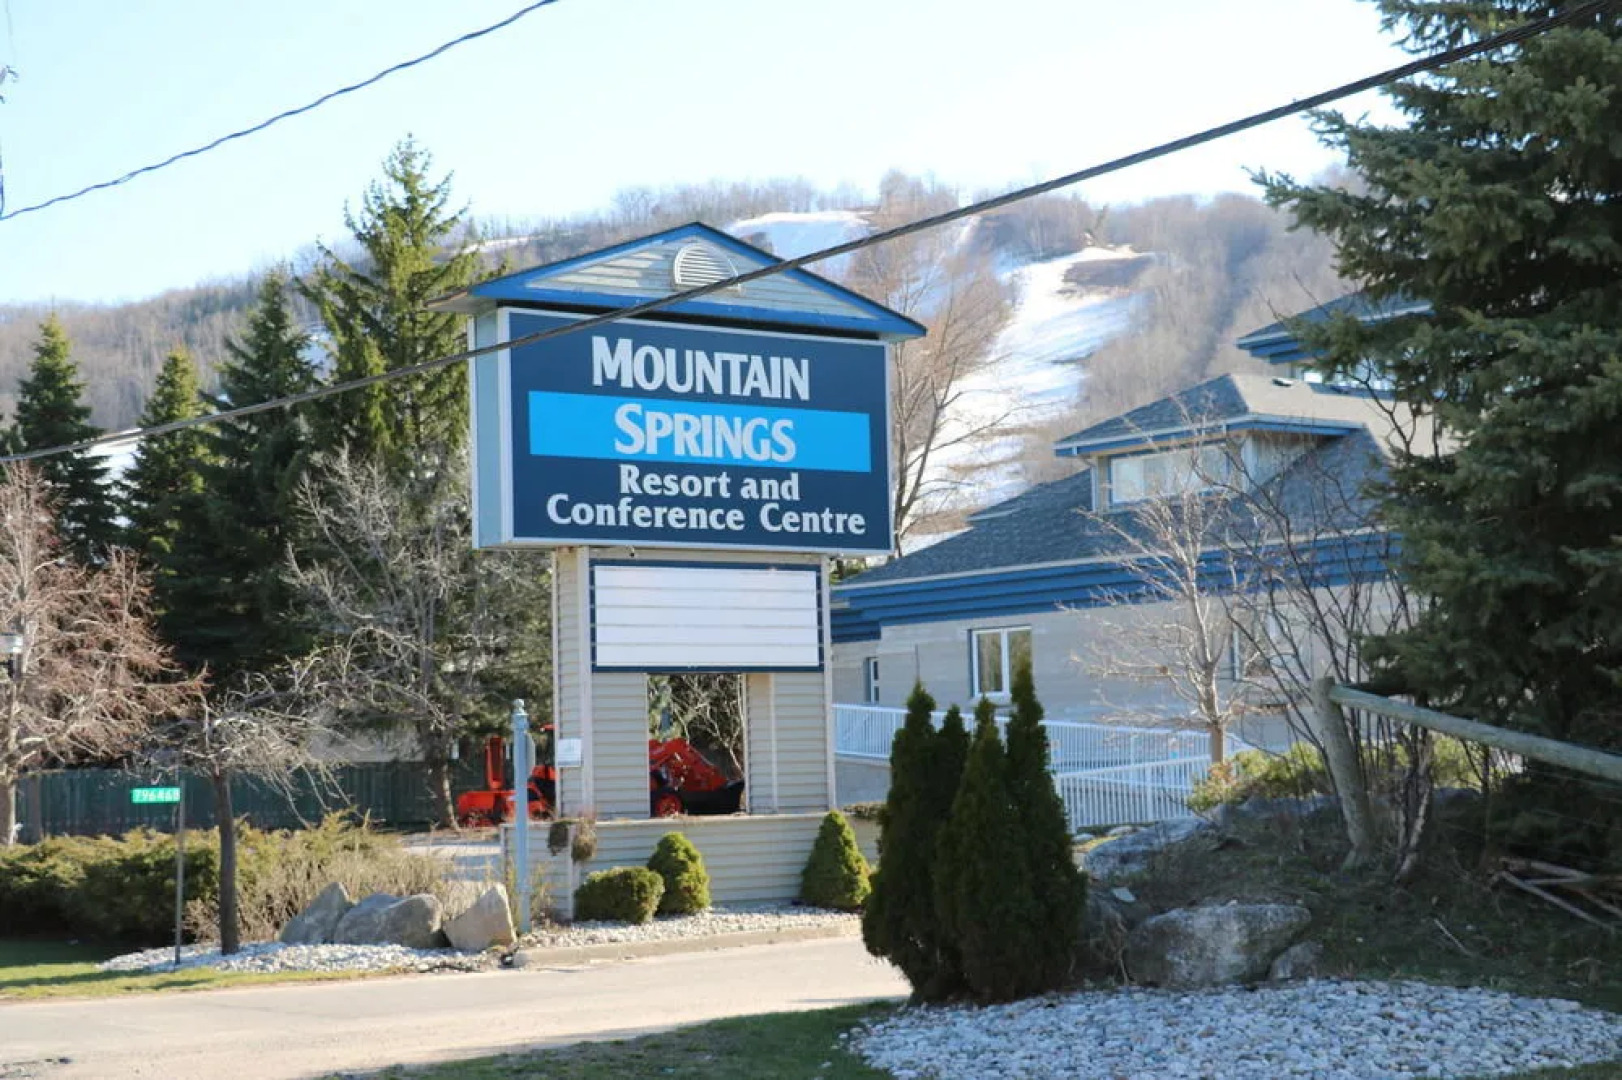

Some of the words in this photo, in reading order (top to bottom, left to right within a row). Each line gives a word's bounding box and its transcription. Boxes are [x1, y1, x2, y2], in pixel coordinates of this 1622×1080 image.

[591, 336, 810, 400] MOUNTAIN
[614, 404, 796, 462] SPRINGS
[619, 465, 731, 497] Resort
[741, 472, 799, 501] and
[547, 494, 745, 531] Conference
[760, 503, 866, 535] Centre
